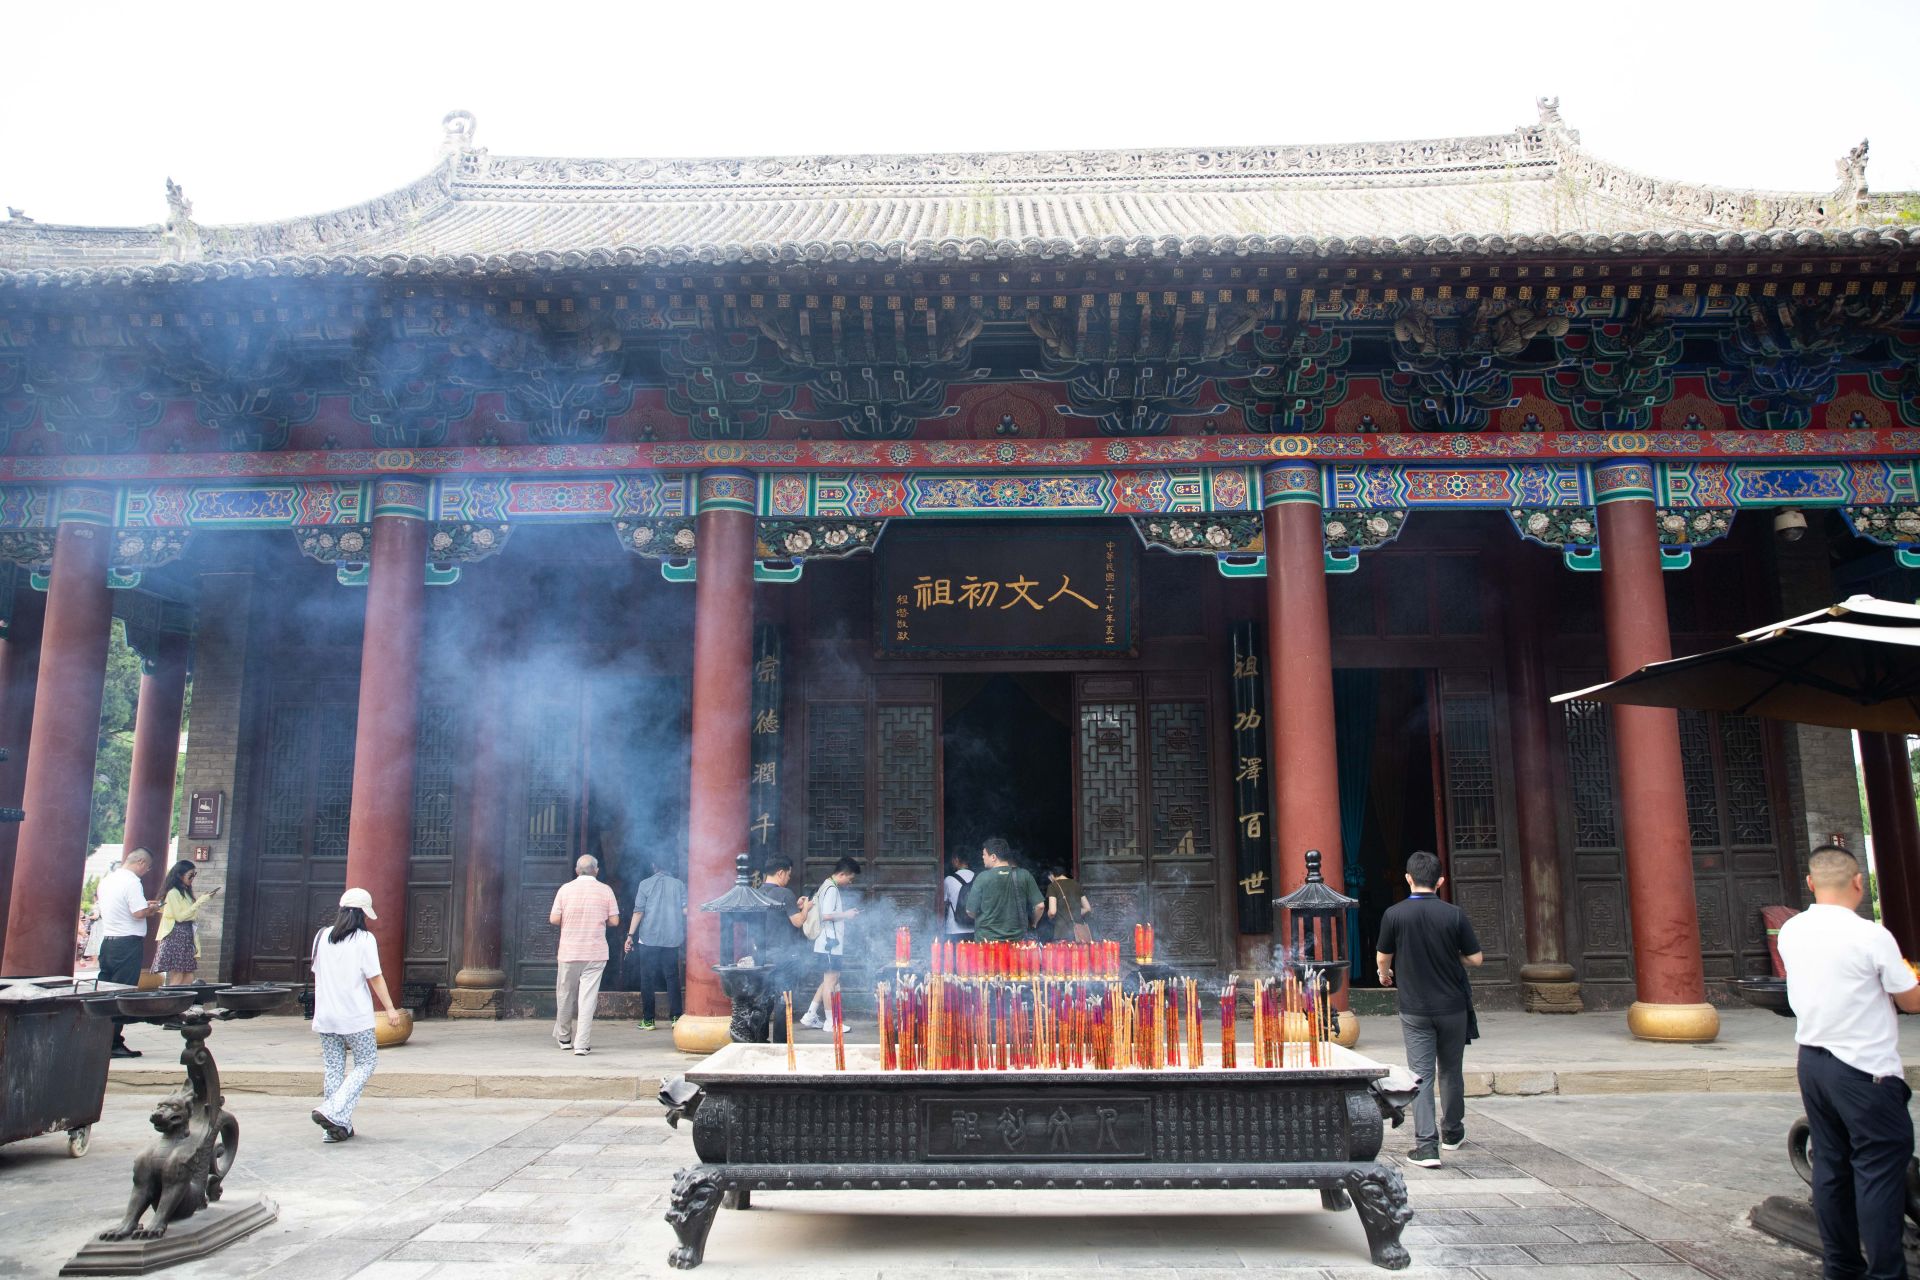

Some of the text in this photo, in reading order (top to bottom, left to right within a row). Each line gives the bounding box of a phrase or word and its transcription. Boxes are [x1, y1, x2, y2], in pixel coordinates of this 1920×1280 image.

[913, 575, 1099, 611] 人文初祖
[1233, 655, 1269, 895] 祖功澤百世
